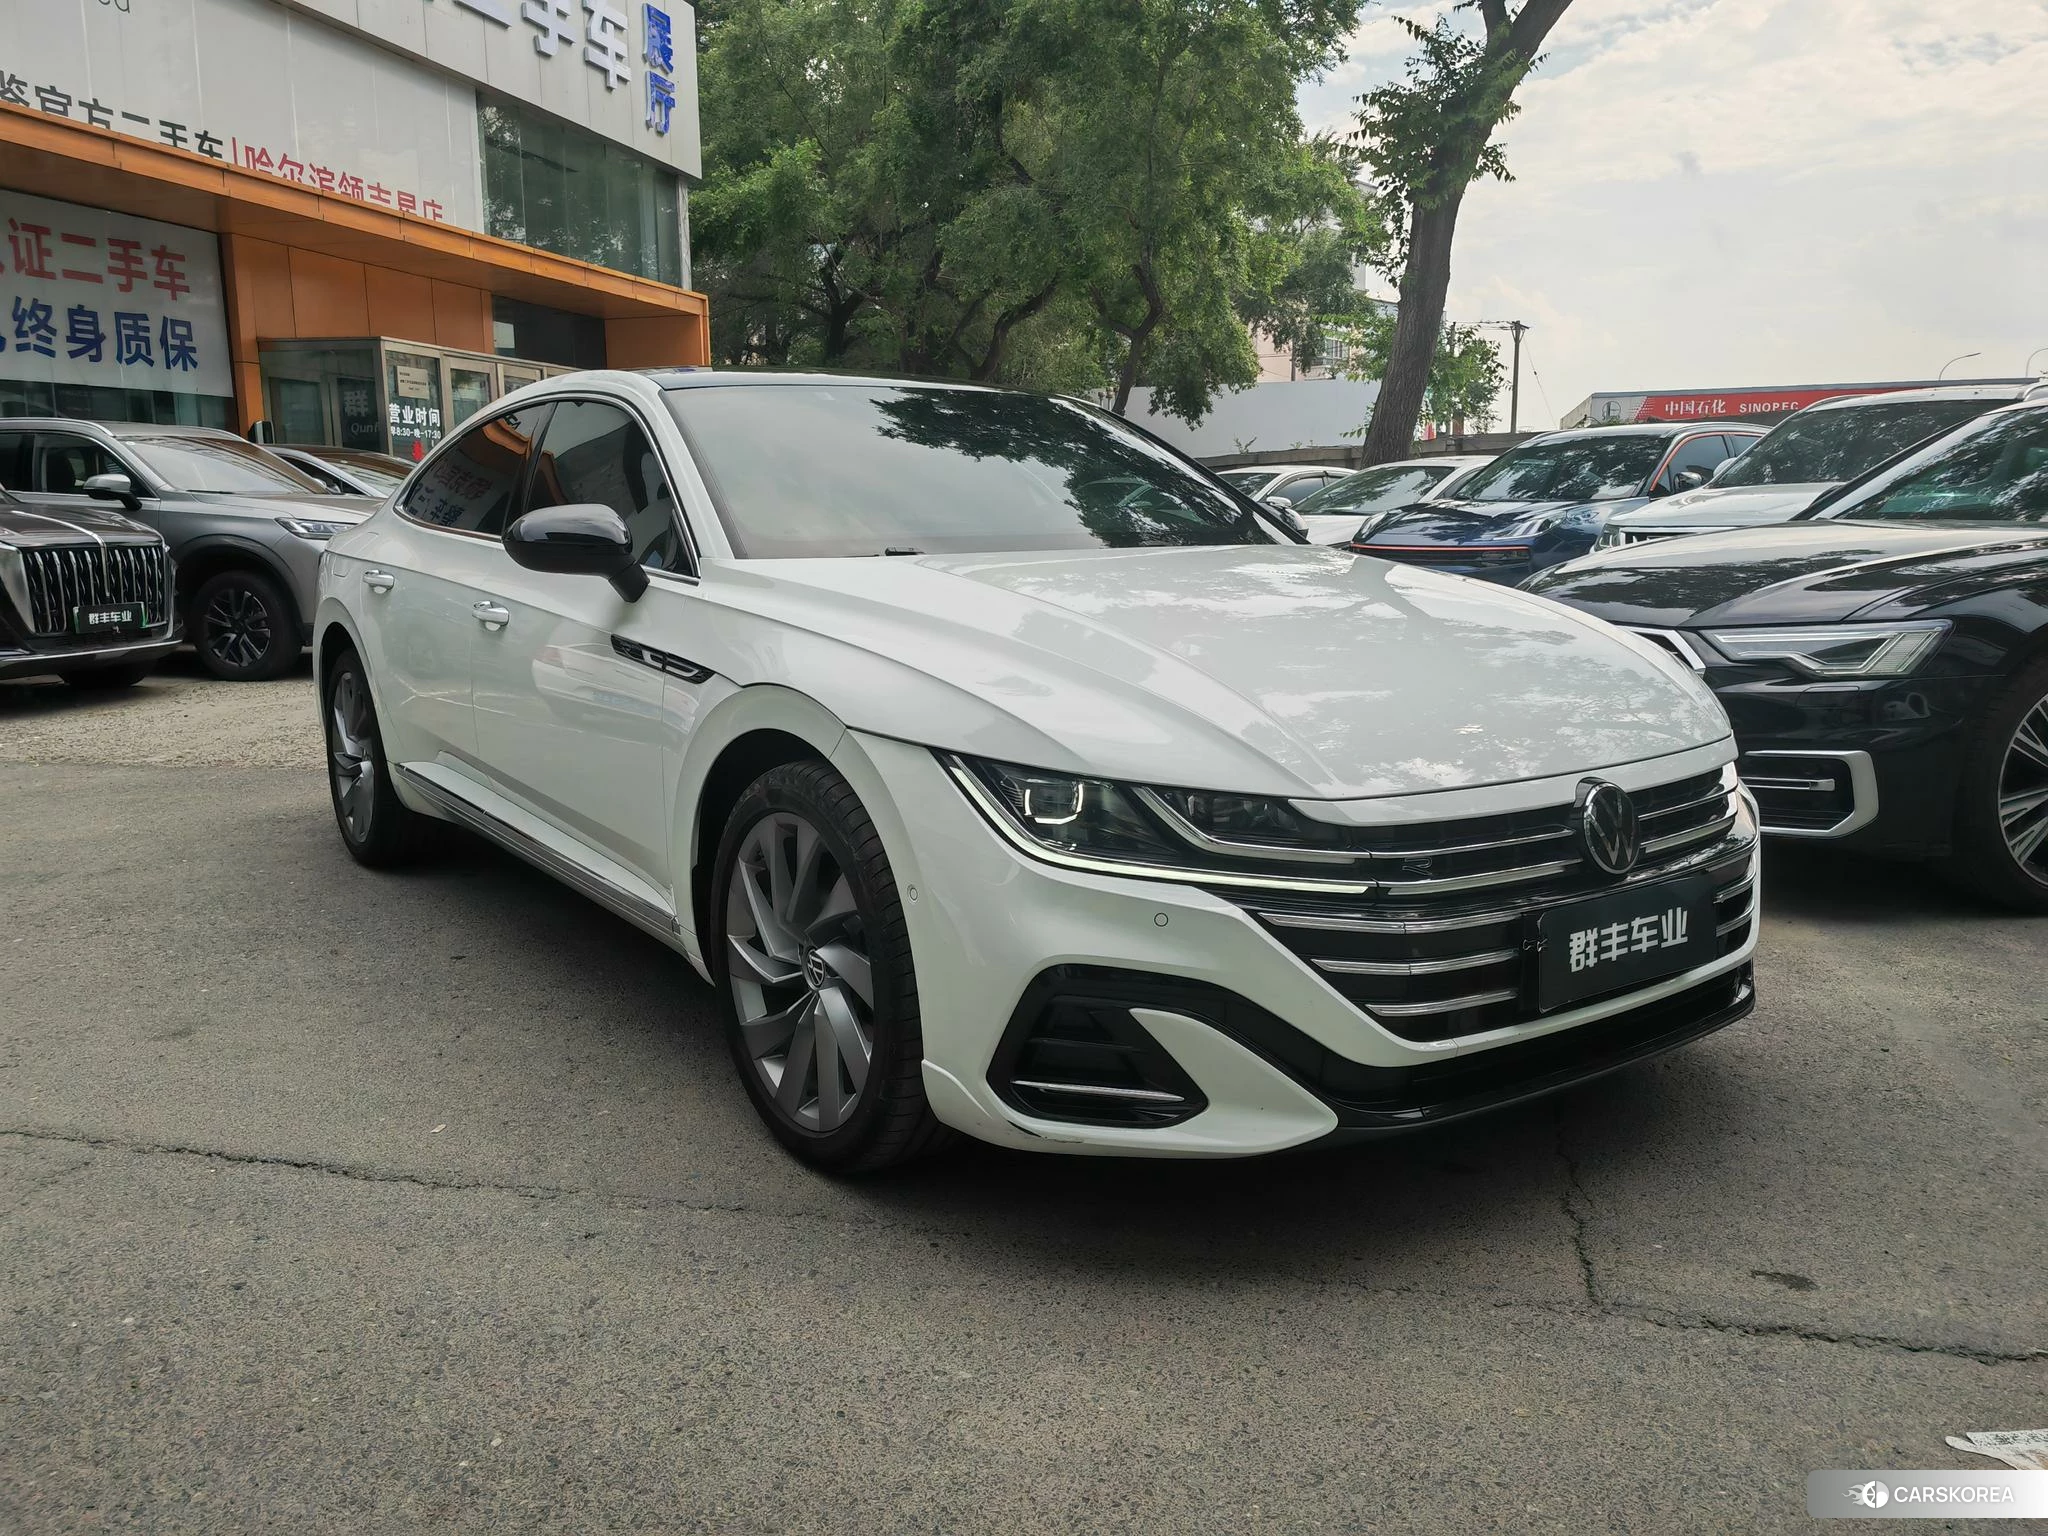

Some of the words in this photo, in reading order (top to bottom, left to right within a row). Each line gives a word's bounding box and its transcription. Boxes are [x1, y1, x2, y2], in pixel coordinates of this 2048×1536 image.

[452, 0, 632, 91] 手车
[643, 3, 676, 136] 展厅
[0, 218, 190, 301] 证二手车
[0, 296, 198, 371] 终身质保
[389, 402, 441, 427] 营业时间
[1665, 399, 1726, 416] 中国石化
[1739, 401, 1799, 414] SINOPEC
[88, 610, 132, 625] 群丰车业
[1570, 906, 1688, 973] 群丰车业
